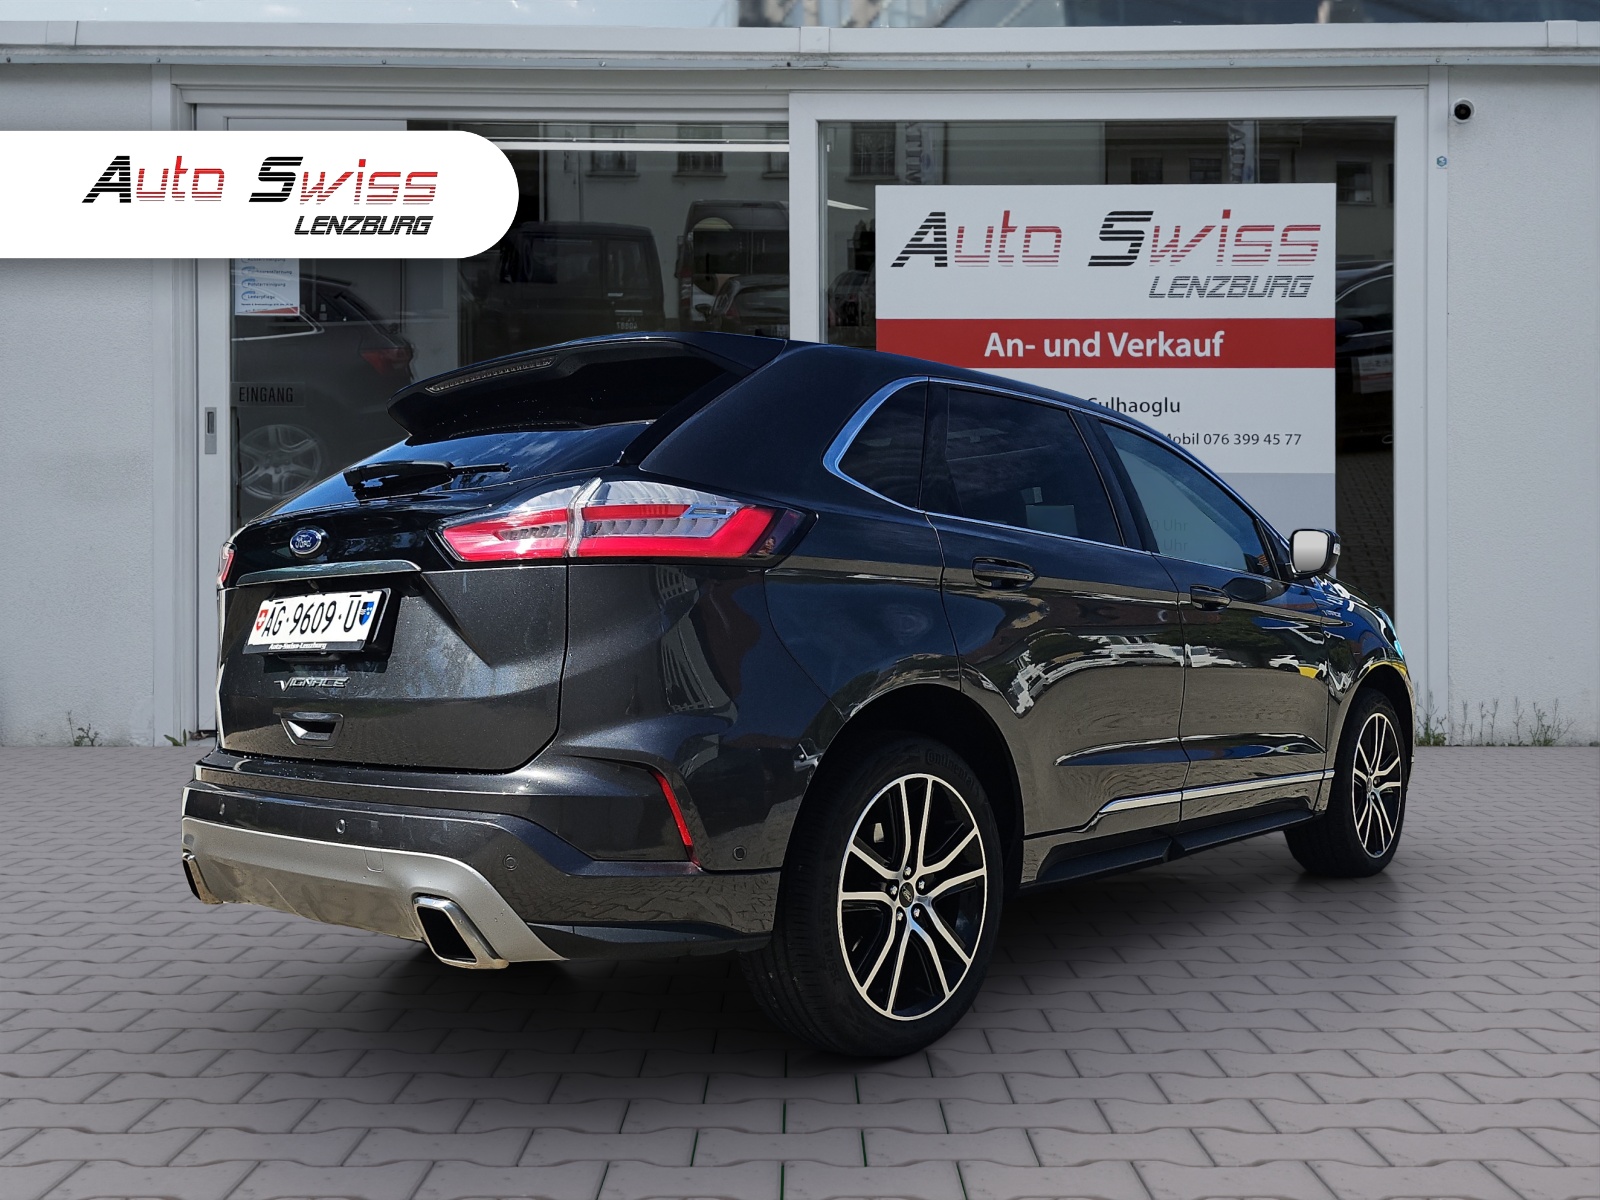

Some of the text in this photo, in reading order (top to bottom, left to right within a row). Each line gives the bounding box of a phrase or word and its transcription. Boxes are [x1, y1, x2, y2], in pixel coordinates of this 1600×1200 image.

[890, 209, 1321, 267] Auto Swiss
[1149, 275, 1314, 298] LENZBURG
[984, 331, 1224, 357] An- und Verkauf
[239, 386, 294, 403] EINGANG
[1203, 433, 1230, 446] 076
[1234, 433, 1260, 446] 399
[1263, 433, 1281, 446] 45
[1285, 433, 1302, 446] 77
[1164, 518, 1189, 532] Uhr
[1164, 538, 1189, 552] Uhr
